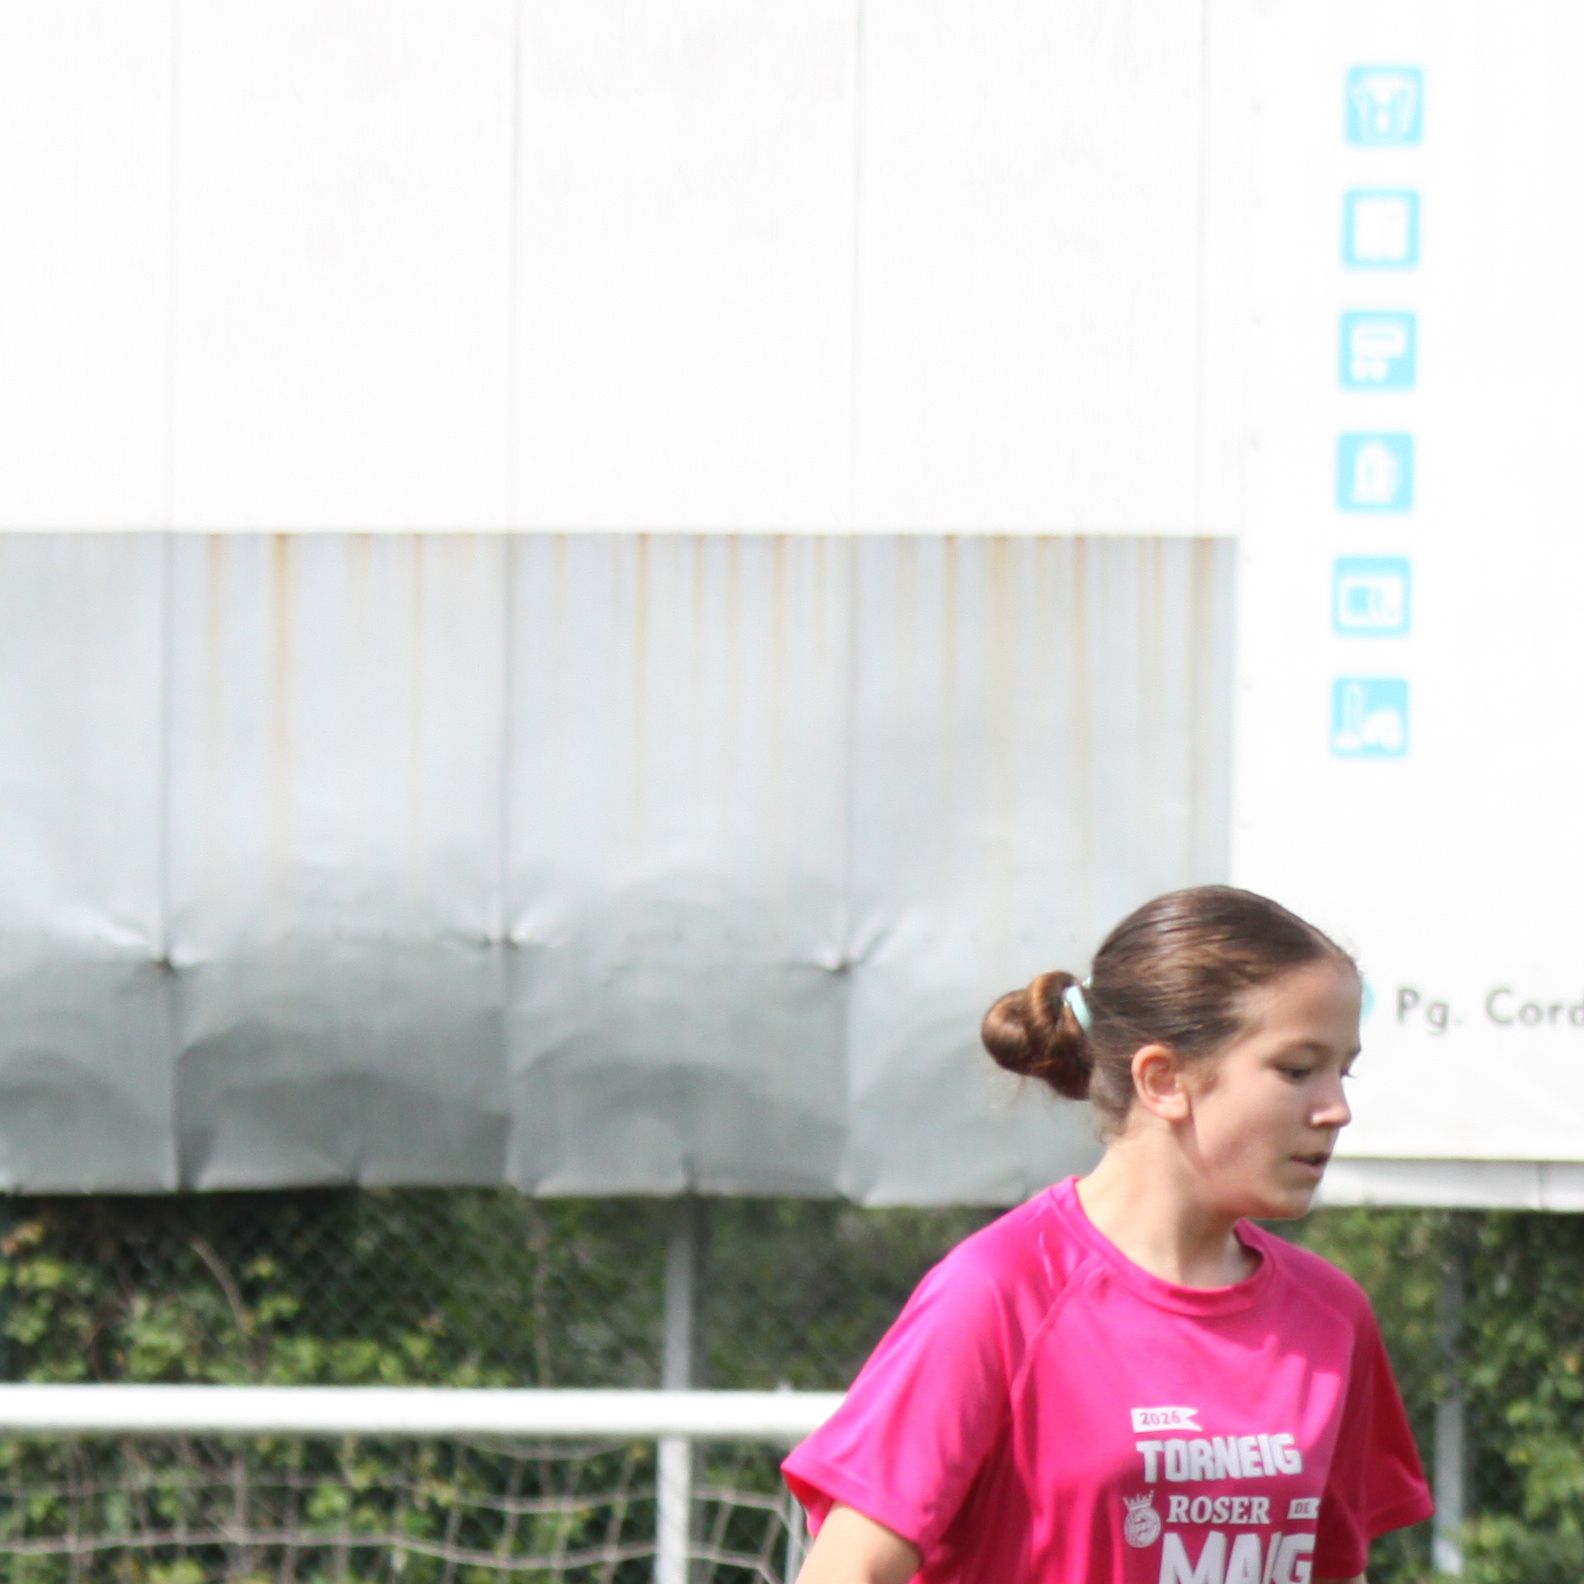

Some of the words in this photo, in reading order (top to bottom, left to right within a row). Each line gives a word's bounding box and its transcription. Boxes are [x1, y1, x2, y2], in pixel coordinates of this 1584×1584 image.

[1395, 983, 1466, 1037] Pg.
[1136, 1433, 1303, 1484] TORNEIG
[1166, 1495, 1271, 1525] ROSER
